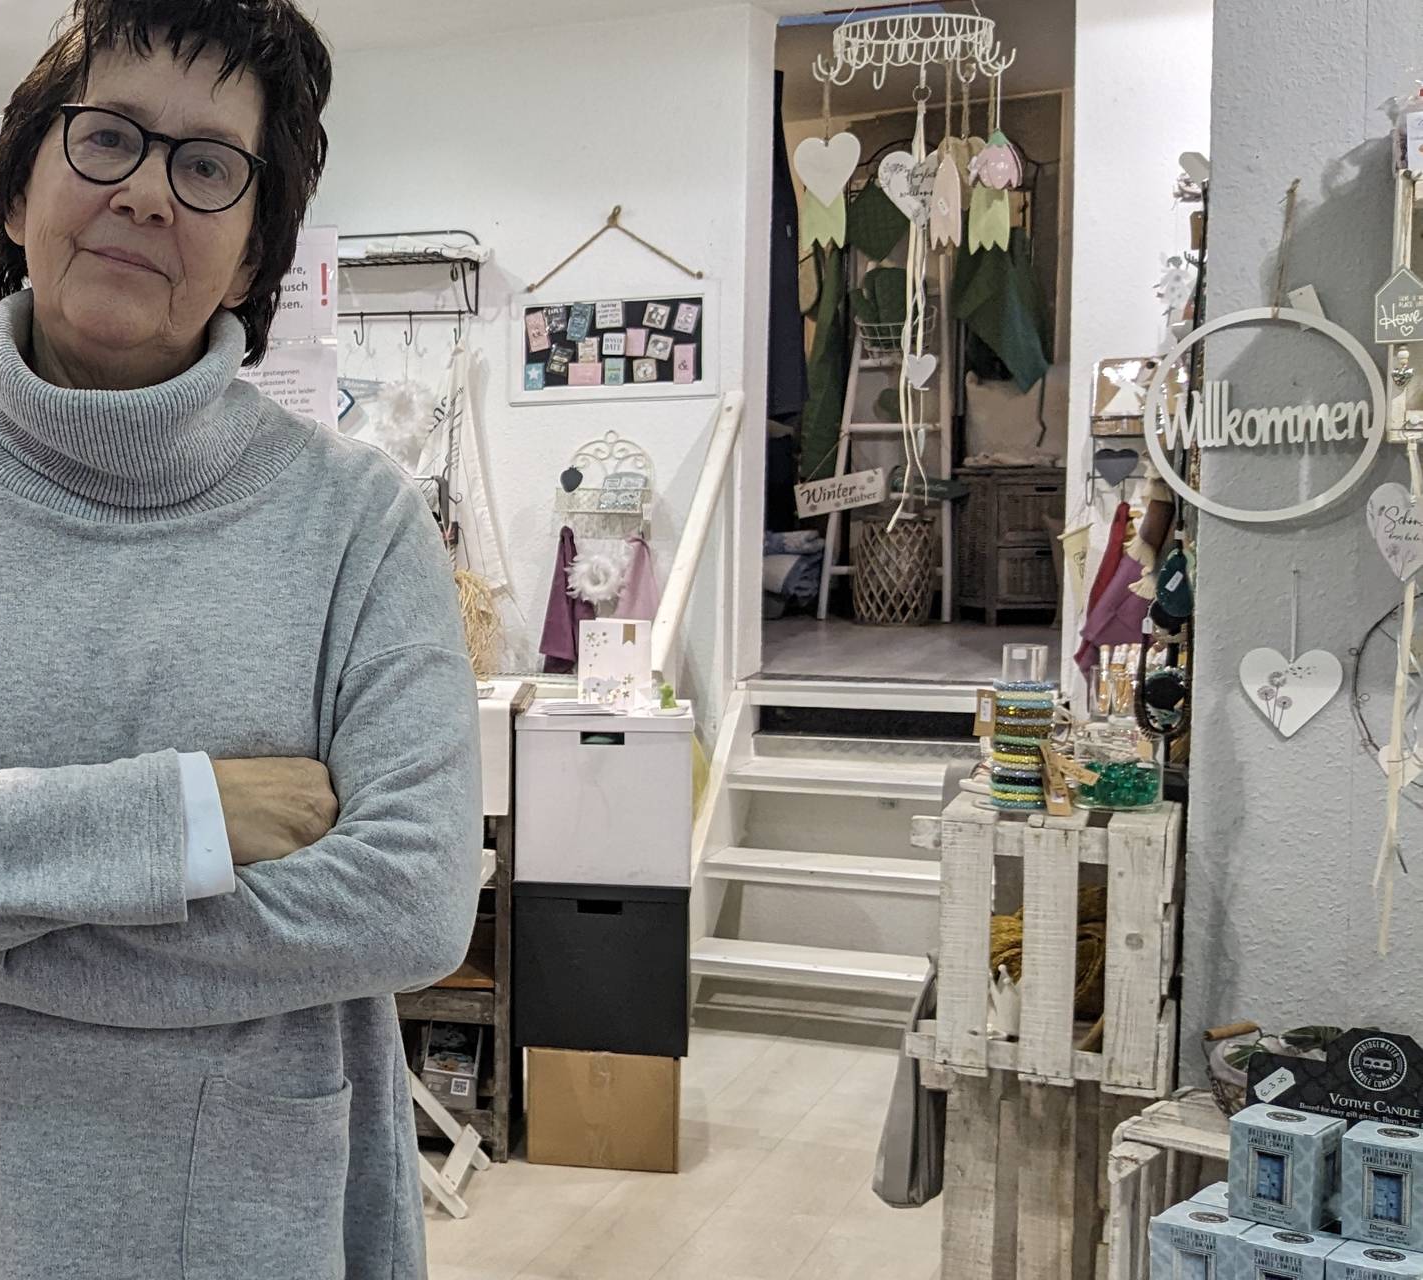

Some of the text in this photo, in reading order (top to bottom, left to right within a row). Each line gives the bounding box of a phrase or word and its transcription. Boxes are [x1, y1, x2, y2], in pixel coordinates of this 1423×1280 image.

[1379, 303, 1423, 330] Home
[1161, 380, 1373, 450] Willkommen
[800, 483, 856, 505] Winter
[1373, 1072, 1400, 1088] COMPANY
[1329, 1093, 1421, 1119] VOTIVE CANDLE
